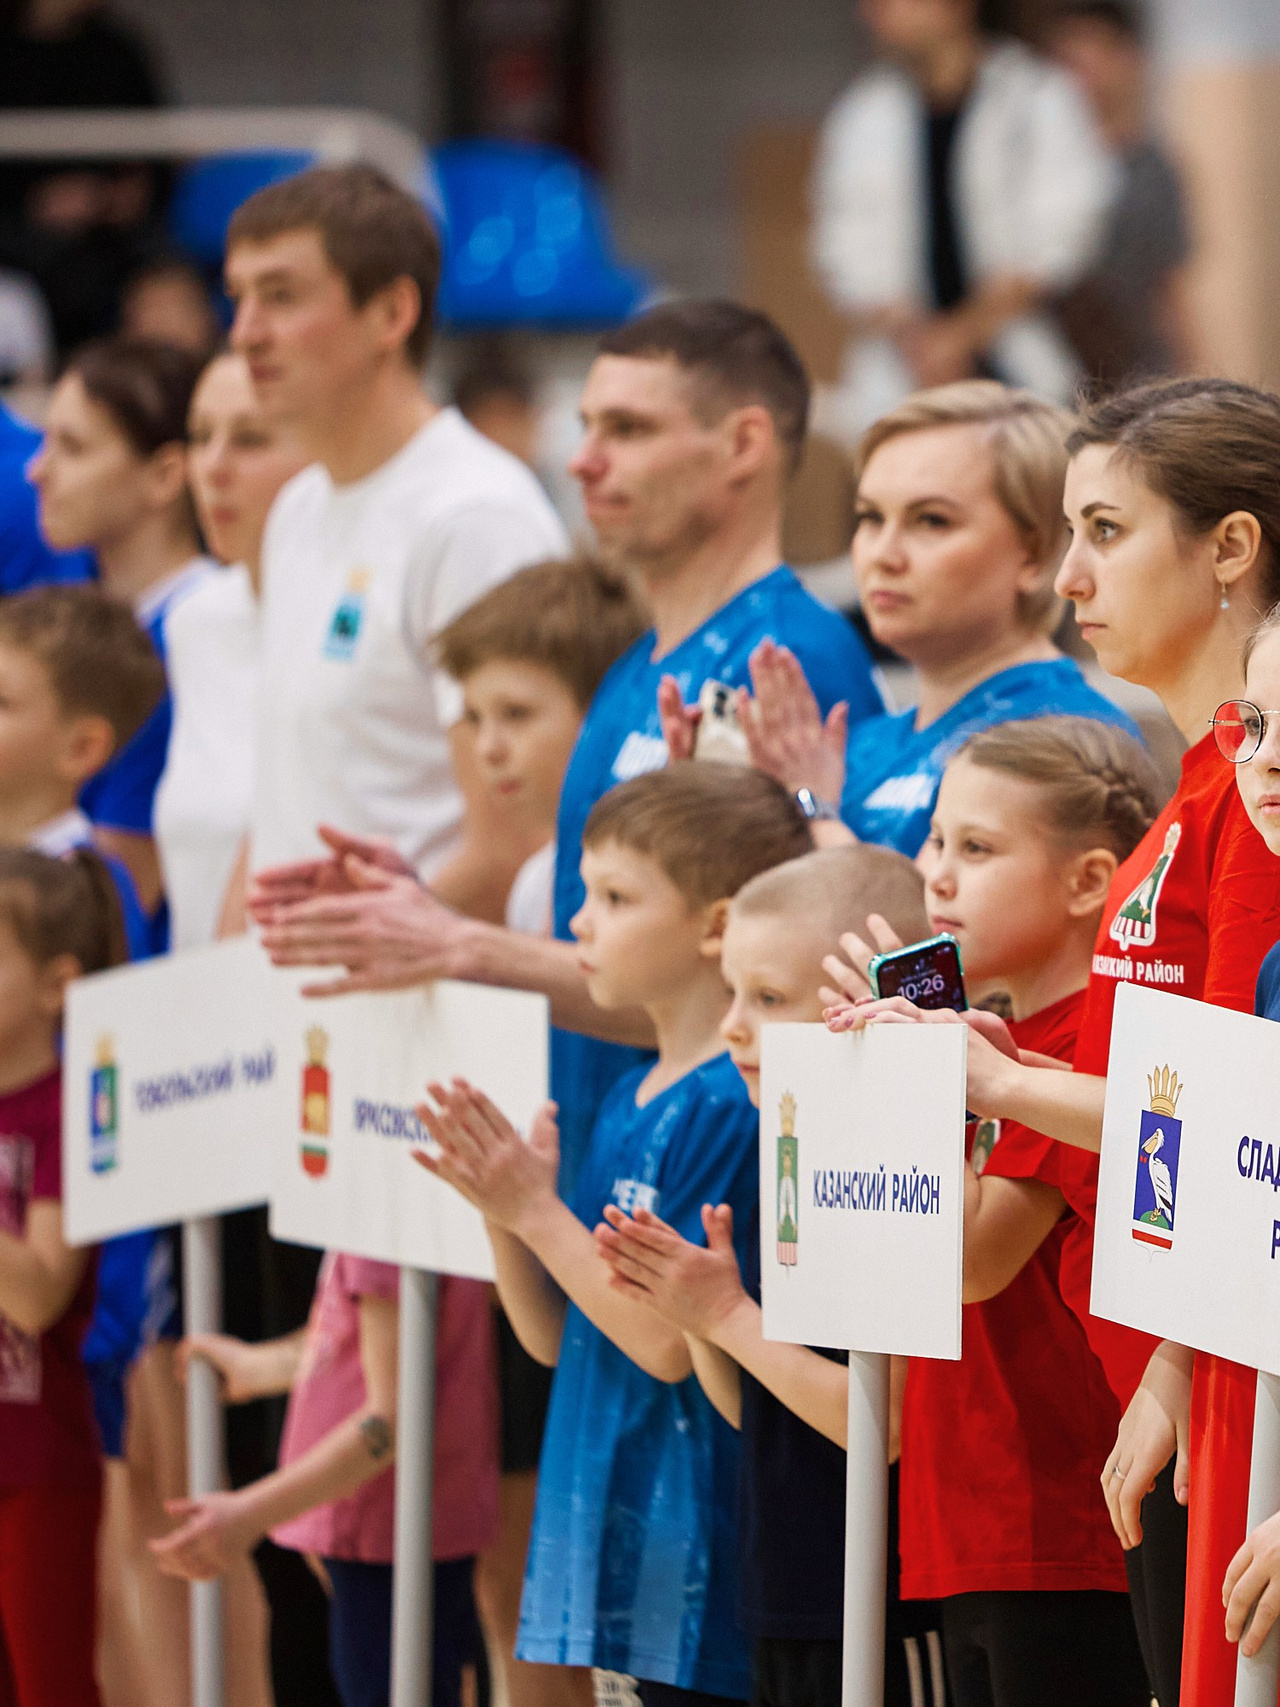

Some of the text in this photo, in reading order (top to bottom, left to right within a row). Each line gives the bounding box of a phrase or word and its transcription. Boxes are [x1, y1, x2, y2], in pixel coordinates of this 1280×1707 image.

[897, 974, 945, 1000] 10:26
[1136, 959, 1185, 984] РАЙОН
[242, 1044, 276, 1085] РАЙ
[813, 1163, 940, 1214] КАЗАНСКИЙ РАЙОН
